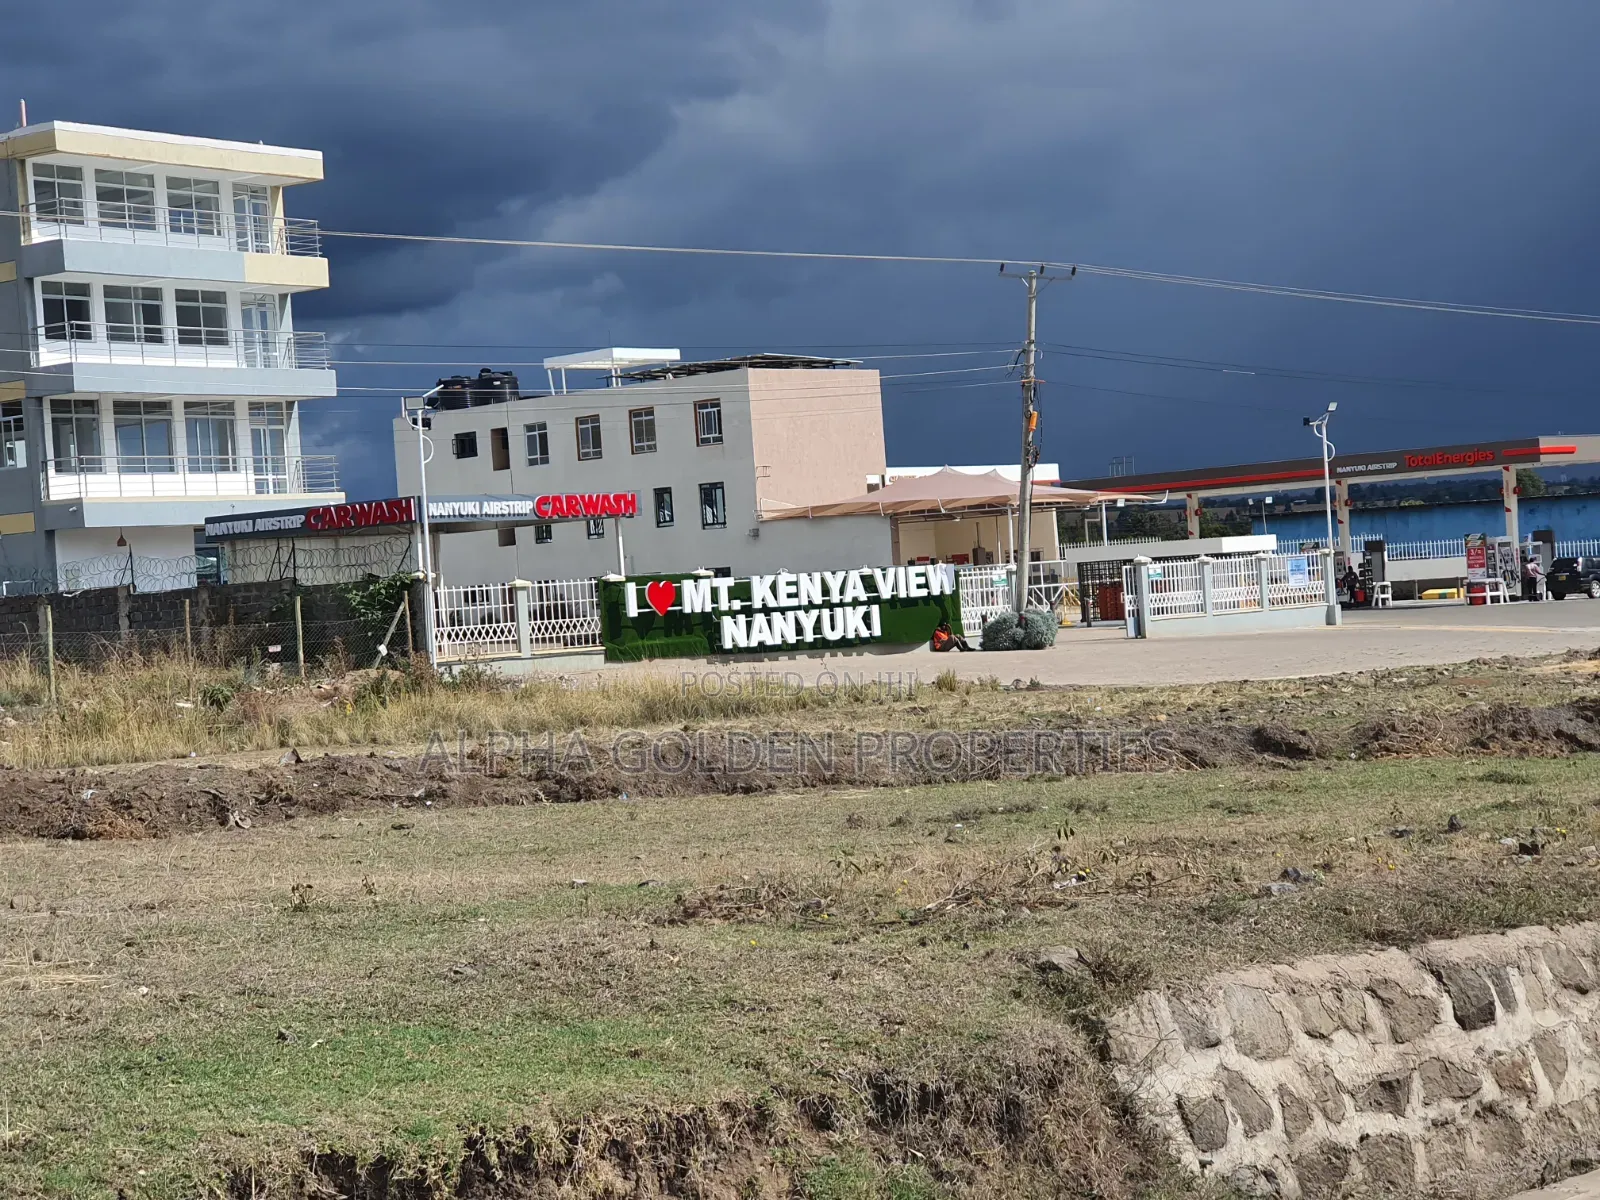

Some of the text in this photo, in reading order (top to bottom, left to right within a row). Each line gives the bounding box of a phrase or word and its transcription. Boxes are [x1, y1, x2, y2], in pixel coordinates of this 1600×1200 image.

[1336, 462, 1398, 474] NANYUKI AIRSTRIP
[1404, 448, 1493, 467] TotalEnergies
[428, 501, 480, 517] NANYUKI
[481, 500, 533, 516] AIRSTRIP
[205, 518, 252, 537] NANYUKI
[253, 514, 306, 532] AIRSTRIP
[681, 576, 741, 614] MT.
[750, 569, 868, 609] KENYA
[871, 563, 955, 600] VIEW
[720, 604, 882, 650] NANYUKI
